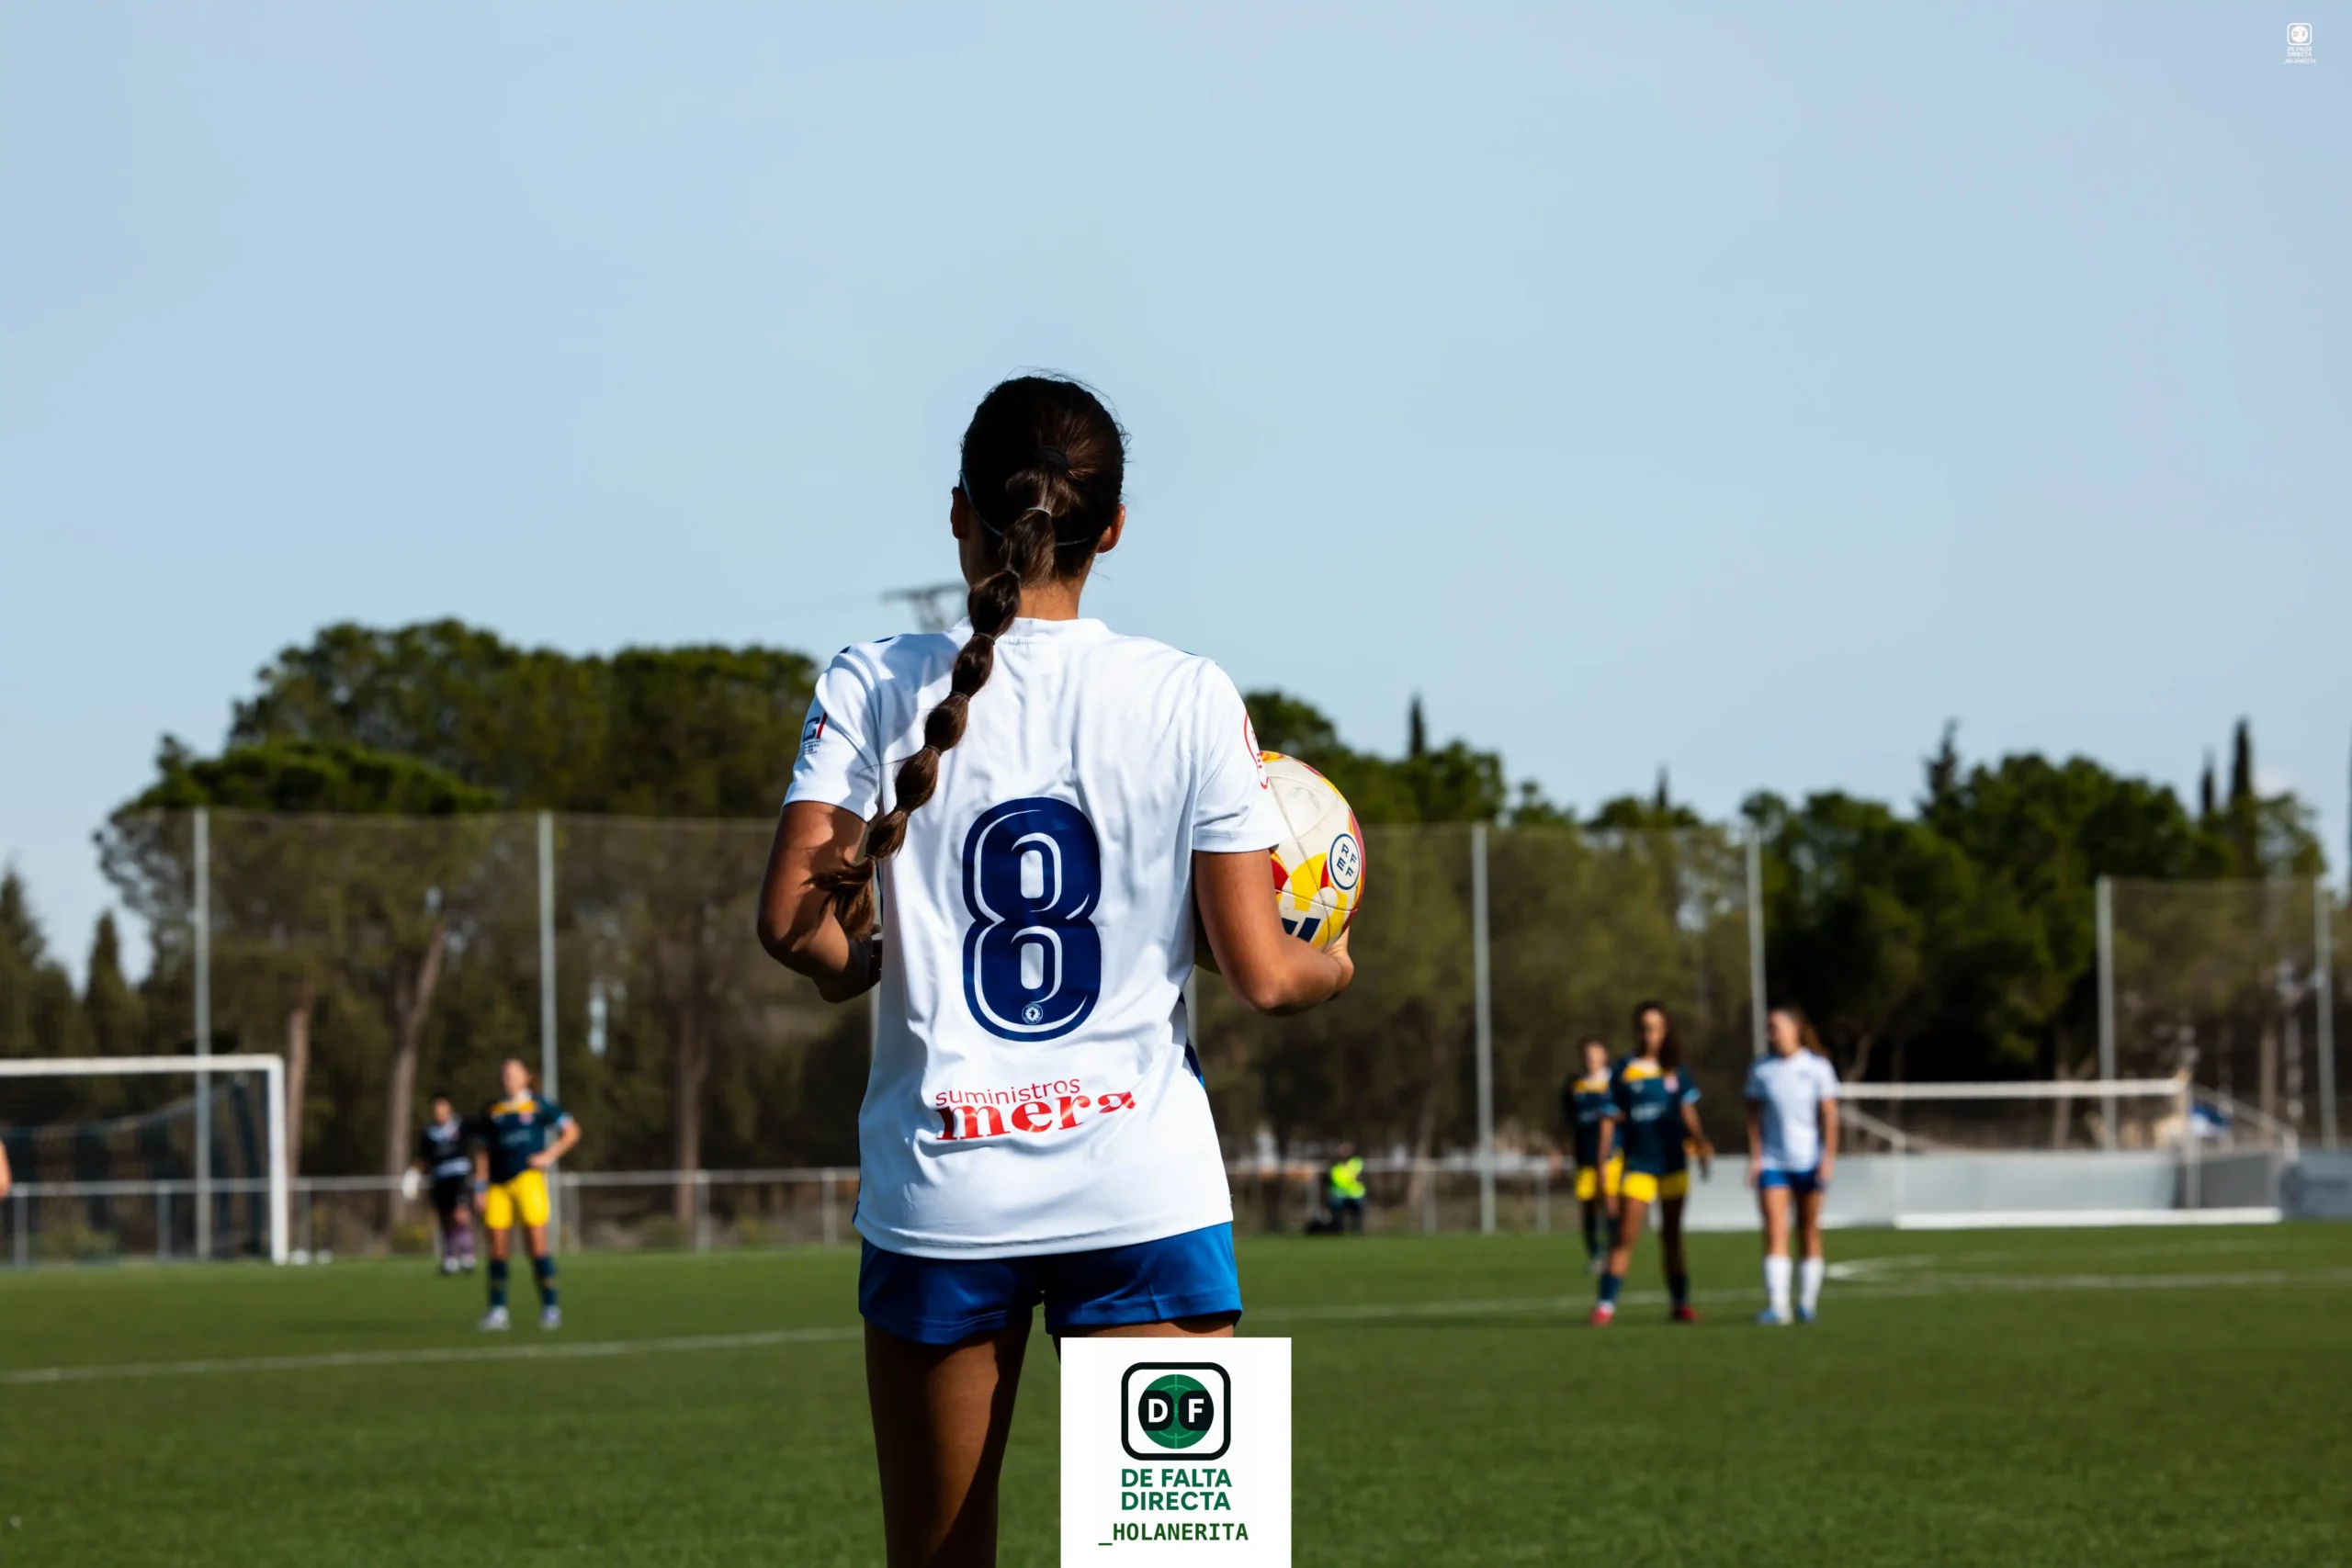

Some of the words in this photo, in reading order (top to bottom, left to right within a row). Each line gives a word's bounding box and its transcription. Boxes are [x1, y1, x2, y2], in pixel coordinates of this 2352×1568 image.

[962, 796, 1102, 1043] 8
[934, 1090, 1136, 1141] mera
[935, 1078, 1080, 1107] suministros
